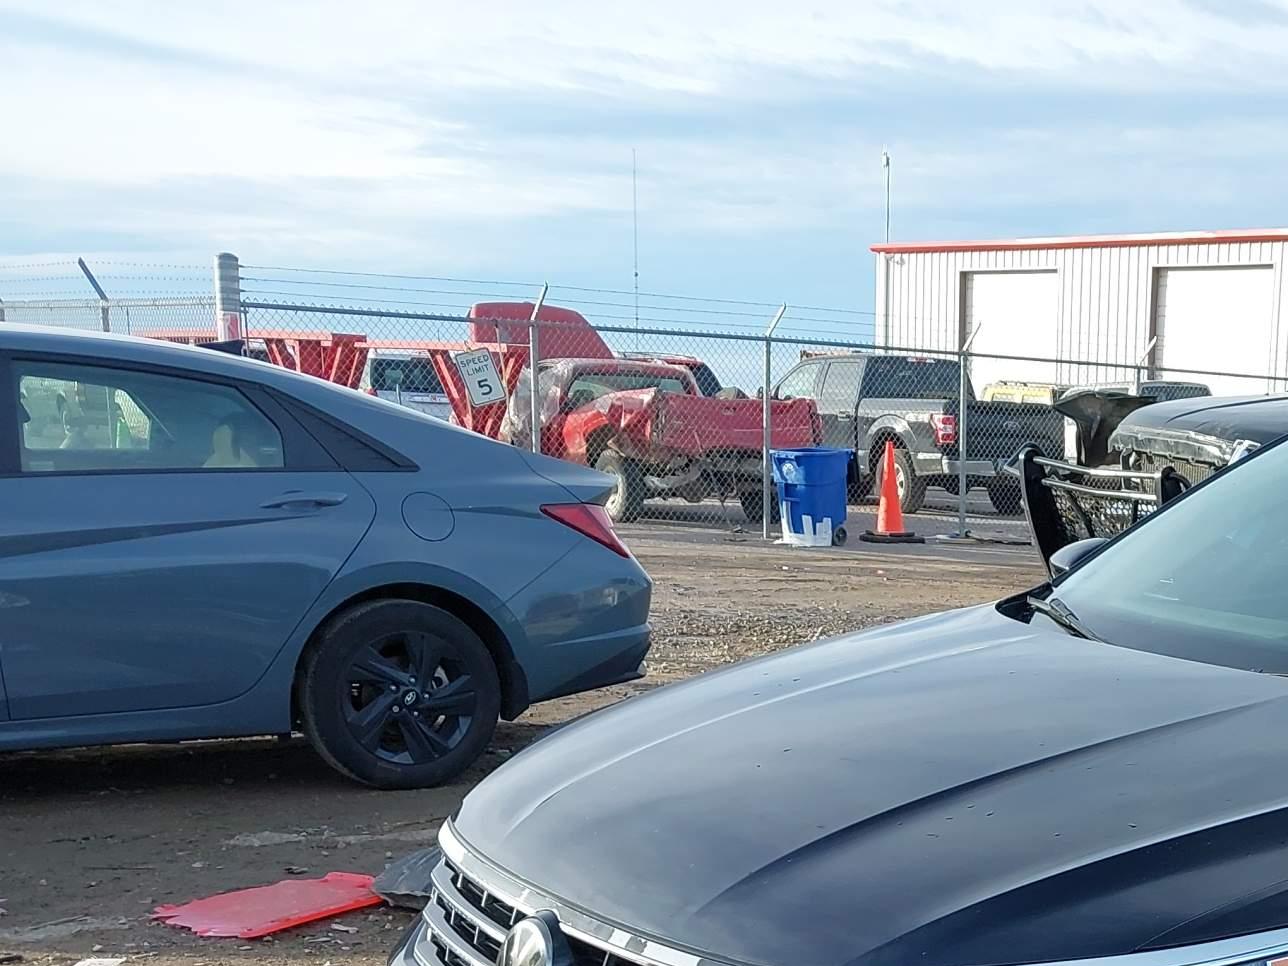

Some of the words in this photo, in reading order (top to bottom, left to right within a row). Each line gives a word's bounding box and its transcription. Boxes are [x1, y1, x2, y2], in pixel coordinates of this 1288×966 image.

[460, 354, 489, 368] SPEED
[466, 364, 489, 376] LIMIT
[477, 378, 493, 396] 5
